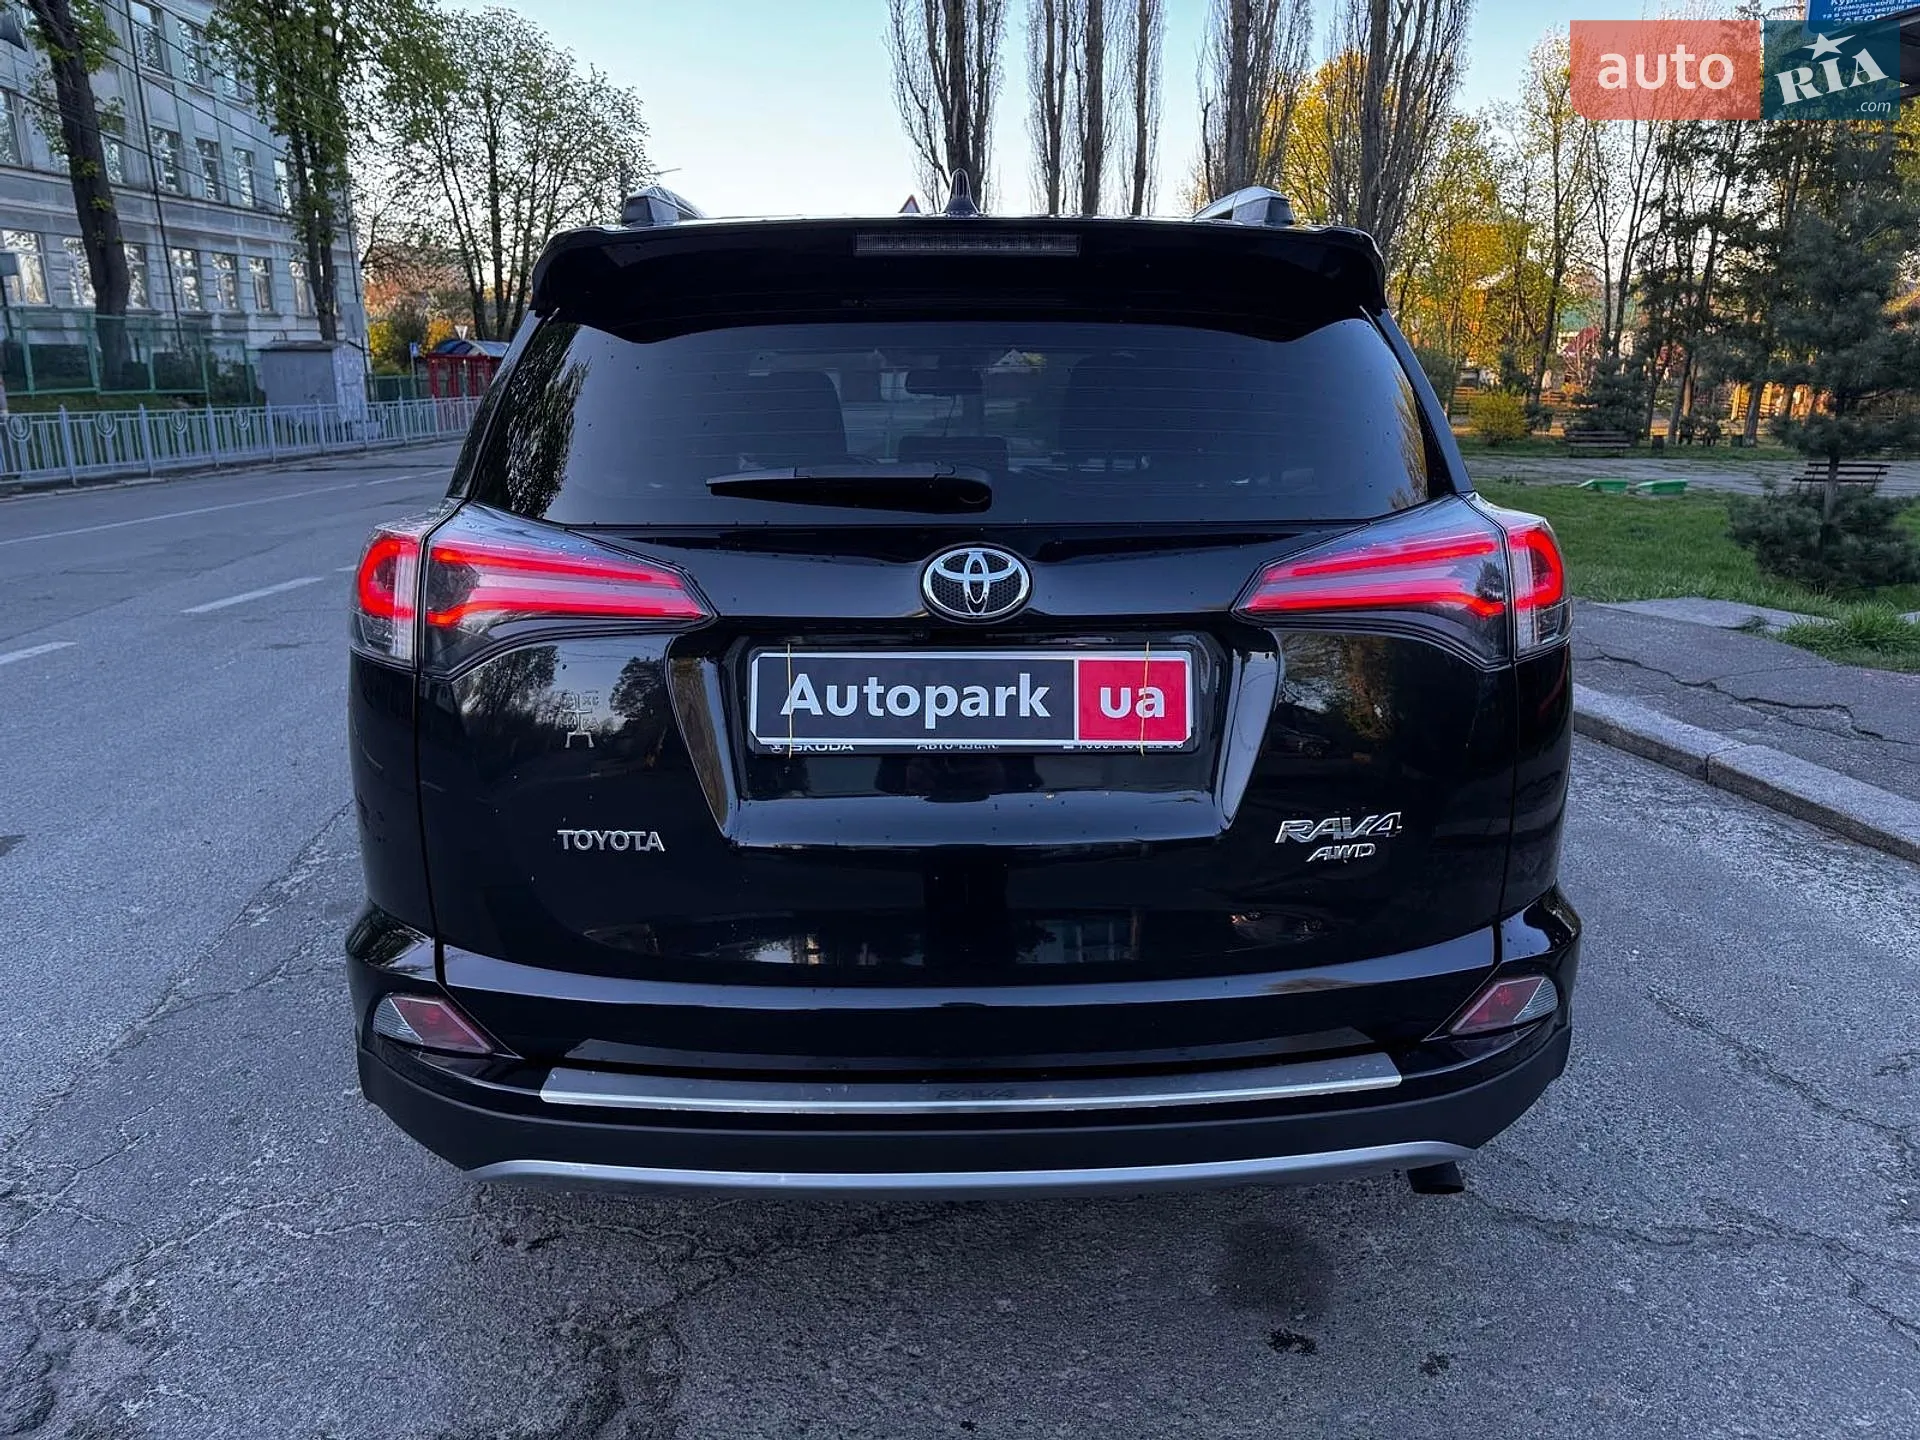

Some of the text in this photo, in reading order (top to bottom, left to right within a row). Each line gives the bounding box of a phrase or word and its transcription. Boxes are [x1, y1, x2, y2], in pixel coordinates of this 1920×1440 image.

[779, 672, 1165, 730] Autopark ua
[557, 829, 665, 852] TOYOTA
[1275, 812, 1403, 844] RAV4
[1306, 843, 1376, 863] AWD
